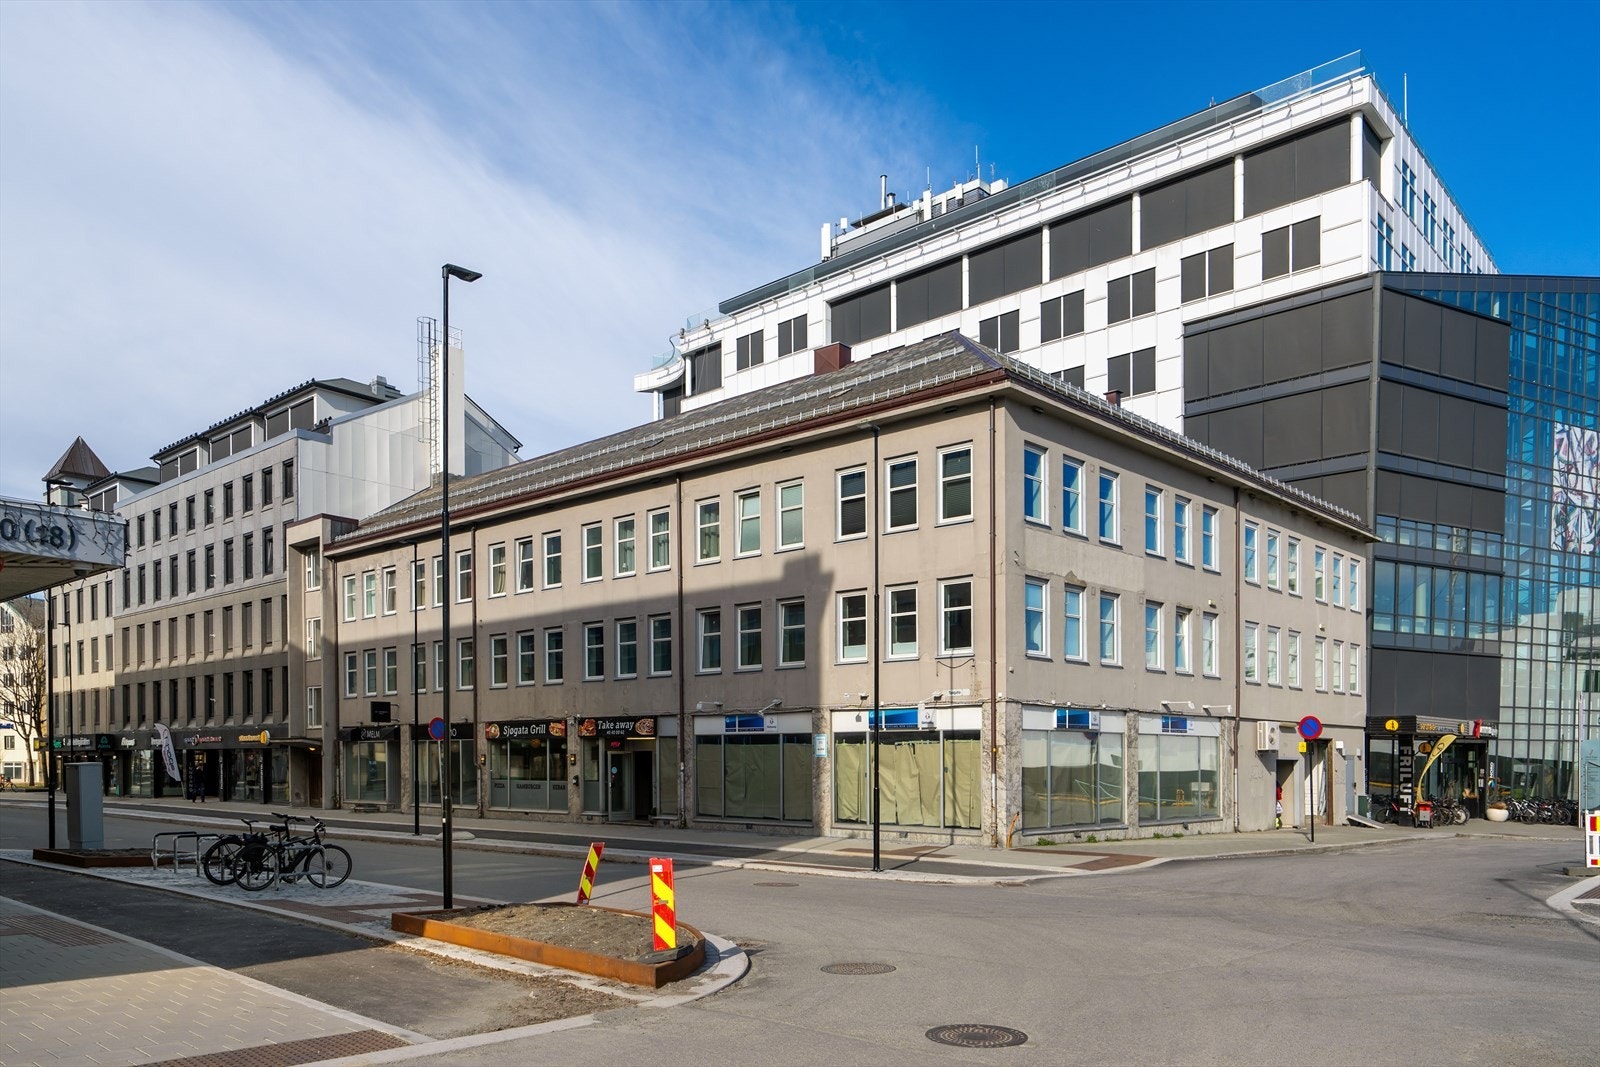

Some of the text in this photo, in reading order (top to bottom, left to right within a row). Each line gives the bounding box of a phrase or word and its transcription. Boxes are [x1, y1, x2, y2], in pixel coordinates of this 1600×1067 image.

[503, 724, 546, 737] Sjøgata Grill
[597, 720, 635, 731] Take away
[1400, 746, 1412, 815] FRILUFT
